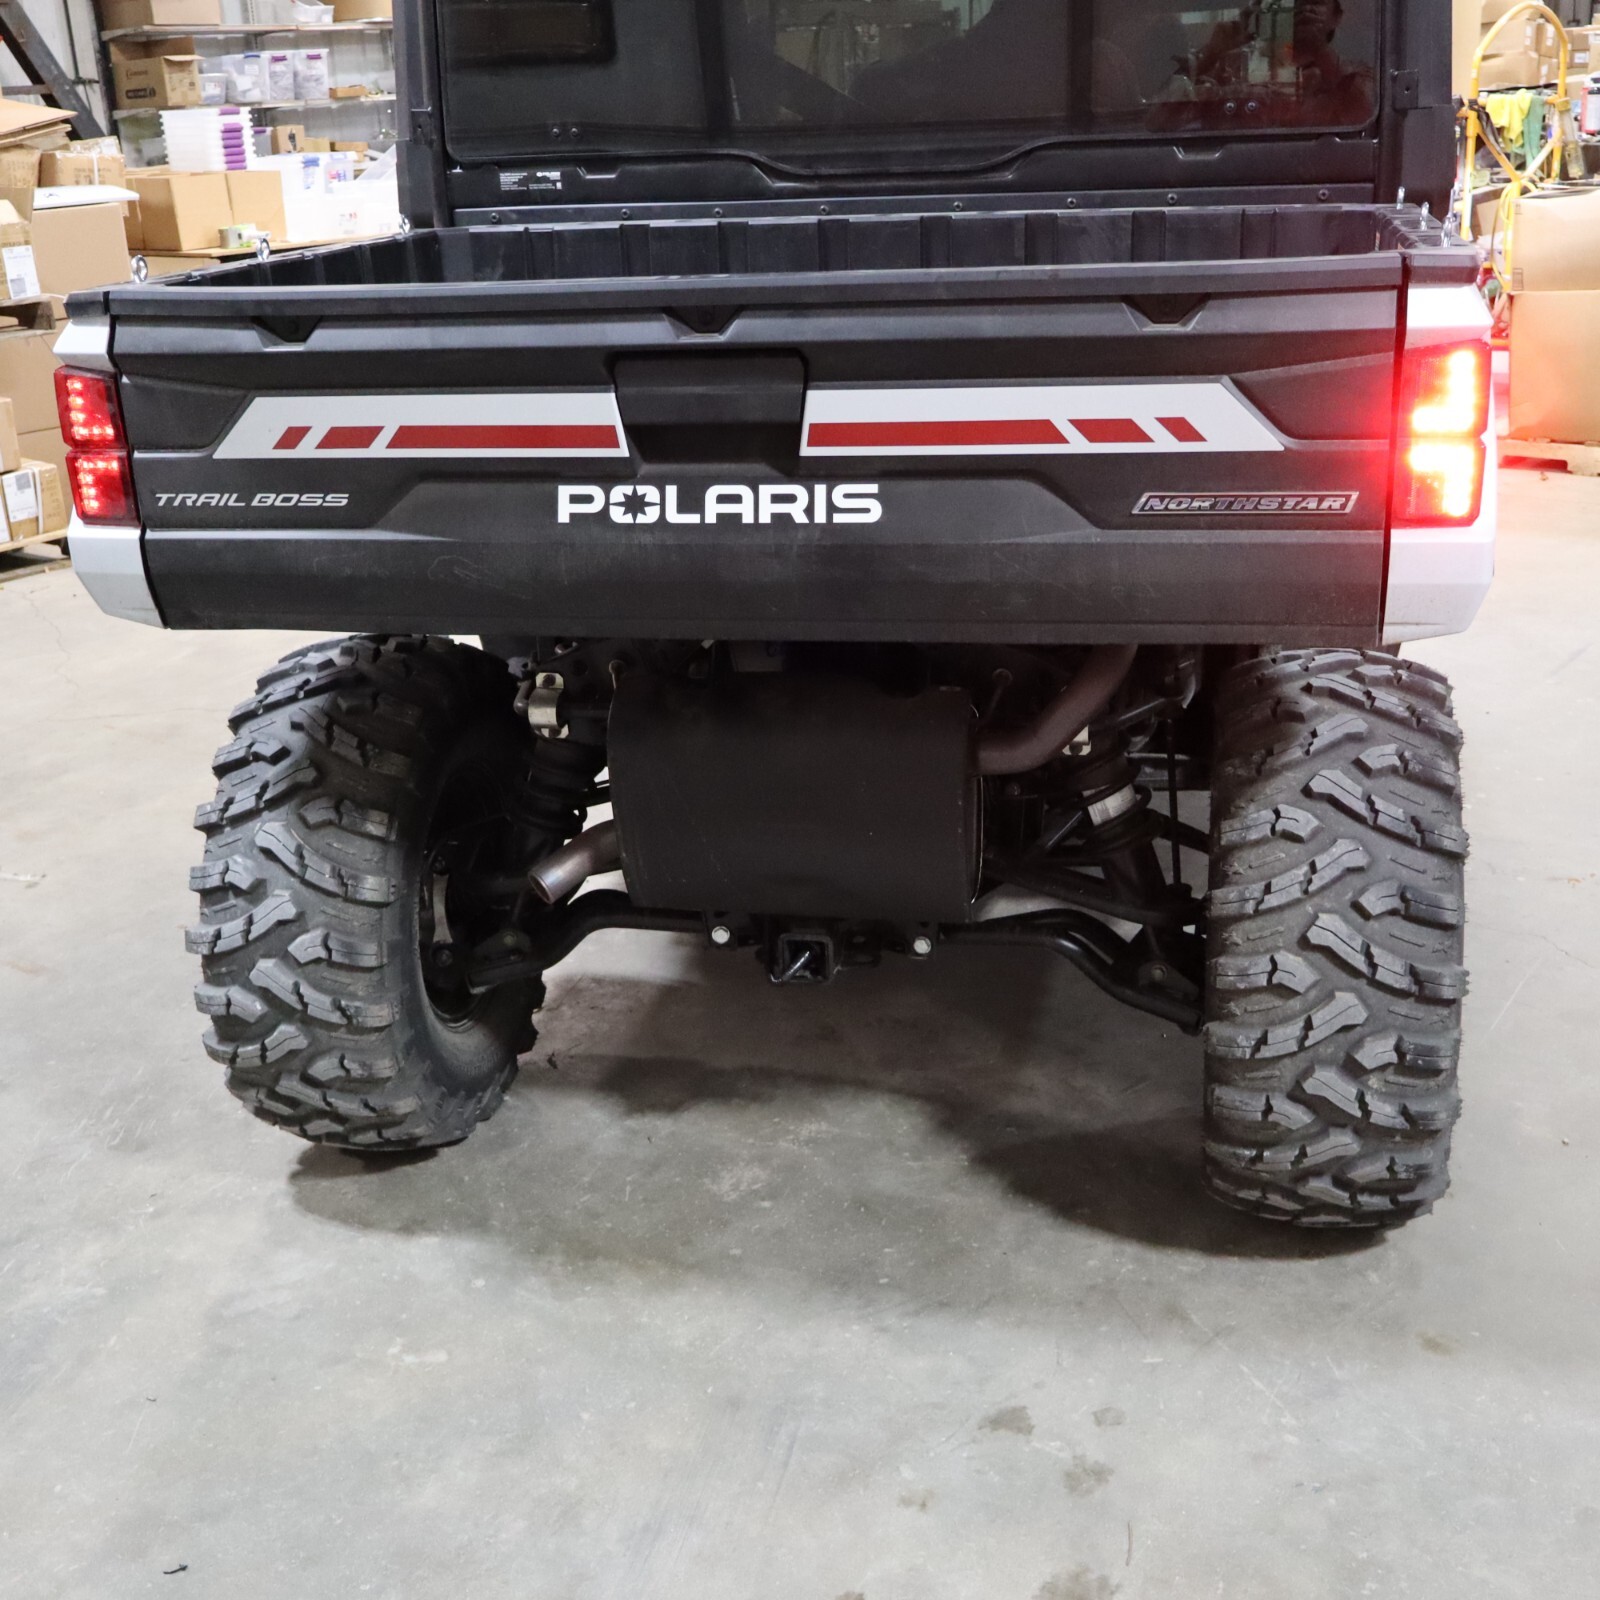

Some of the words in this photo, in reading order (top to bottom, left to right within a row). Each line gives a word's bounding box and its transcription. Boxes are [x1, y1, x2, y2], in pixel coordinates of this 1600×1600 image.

[155, 493, 245, 506] TRAIL
[251, 493, 349, 506] BOSS
[557, 484, 883, 524] POLARIS
[1144, 497, 1346, 510] NORTHSTAR
